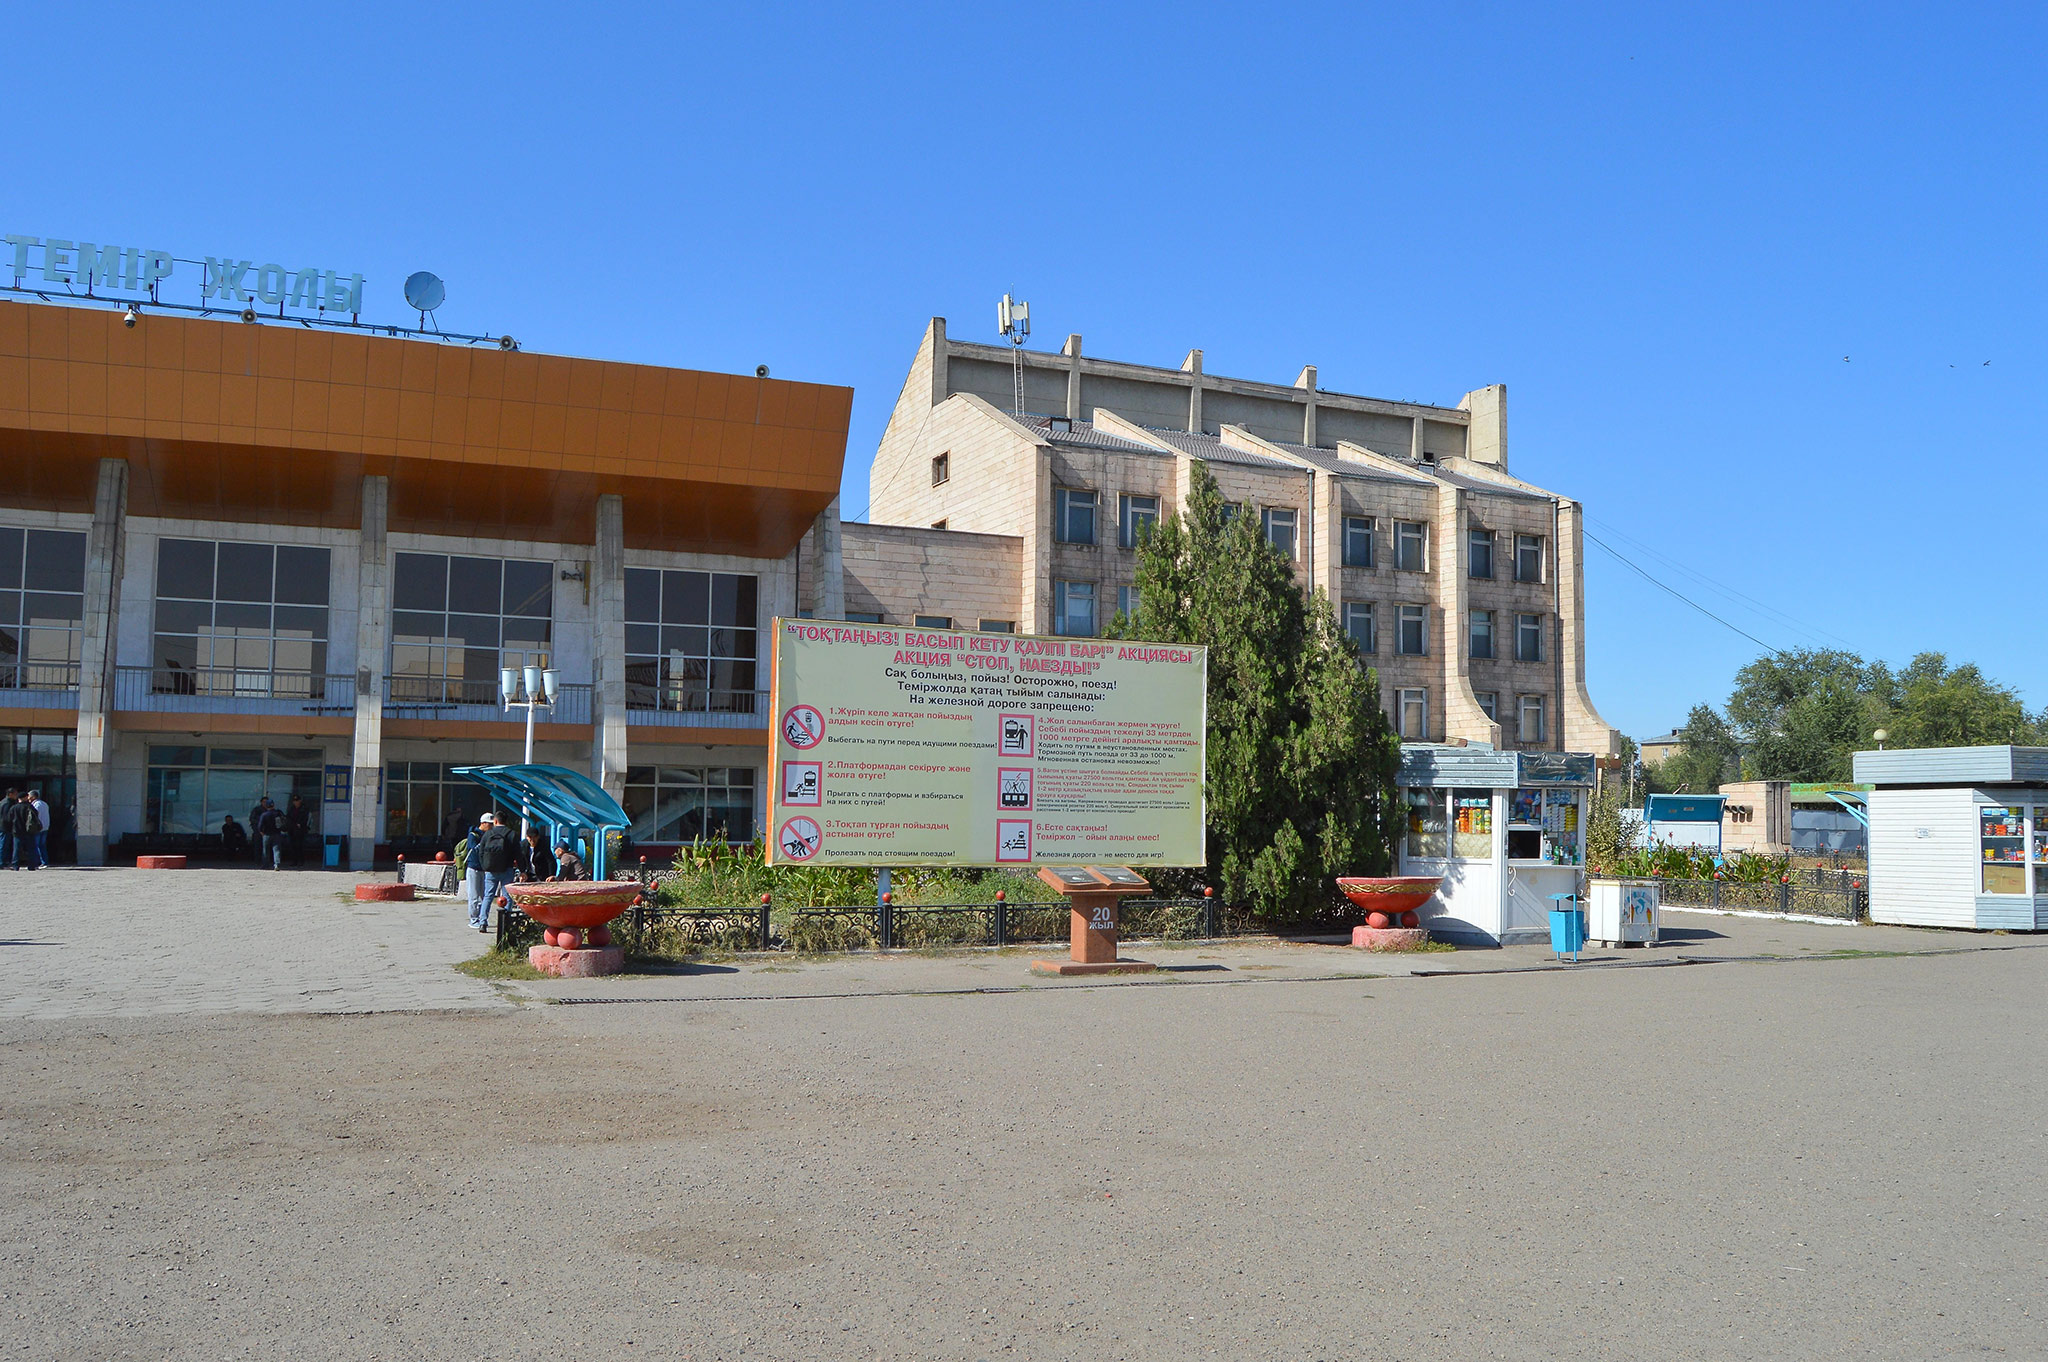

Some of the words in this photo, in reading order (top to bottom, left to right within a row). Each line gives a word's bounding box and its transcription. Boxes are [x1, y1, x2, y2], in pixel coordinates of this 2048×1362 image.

[6, 234, 172, 291] ТЕМІР
[202, 256, 363, 314] ЖОЛЫ
[905, 633, 964, 650] БАСЫП
[970, 638, 1010, 652] КЕТУ
[1118, 648, 1192, 663] АКЦИЯСЫ
[894, 650, 951, 668] АКЦИЯ
[885, 668, 907, 679] Сақ
[911, 669, 966, 682] болыңыз,
[971, 672, 1010, 684] пойыз!
[1014, 675, 1077, 688] Осторожно,
[1081, 679, 1117, 690] поезд!
[898, 681, 966, 694] Теміржолда
[971, 688, 1002, 697] қатаң
[1006, 687, 1044, 698] тыйым
[1048, 690, 1105, 701] салынады:
[910, 694, 926, 705] На
[928, 696, 984, 707] железной
[987, 700, 1026, 709] дороге
[1030, 701, 1094, 712] запрещено:
[829, 707, 865, 717] 1.Жүріп
[927, 712, 973, 721] пойыздың
[860, 719, 884, 727] кесіп
[887, 720, 914, 728] өтуге!
[1067, 719, 1115, 727] салынбаған
[1069, 726, 1110, 735] пойыздың
[827, 760, 906, 771] 2.Платформадан
[909, 764, 945, 772] секіруге
[858, 772, 886, 780] өтуге!
[827, 790, 859, 798] Прыгать
[826, 820, 867, 829] 3.Тоқтап
[903, 821, 949, 830] пойыздың
[867, 831, 894, 839] өтуге!
[1036, 833, 1075, 841] Теміржол
[1092, 907, 1110, 921] 20
